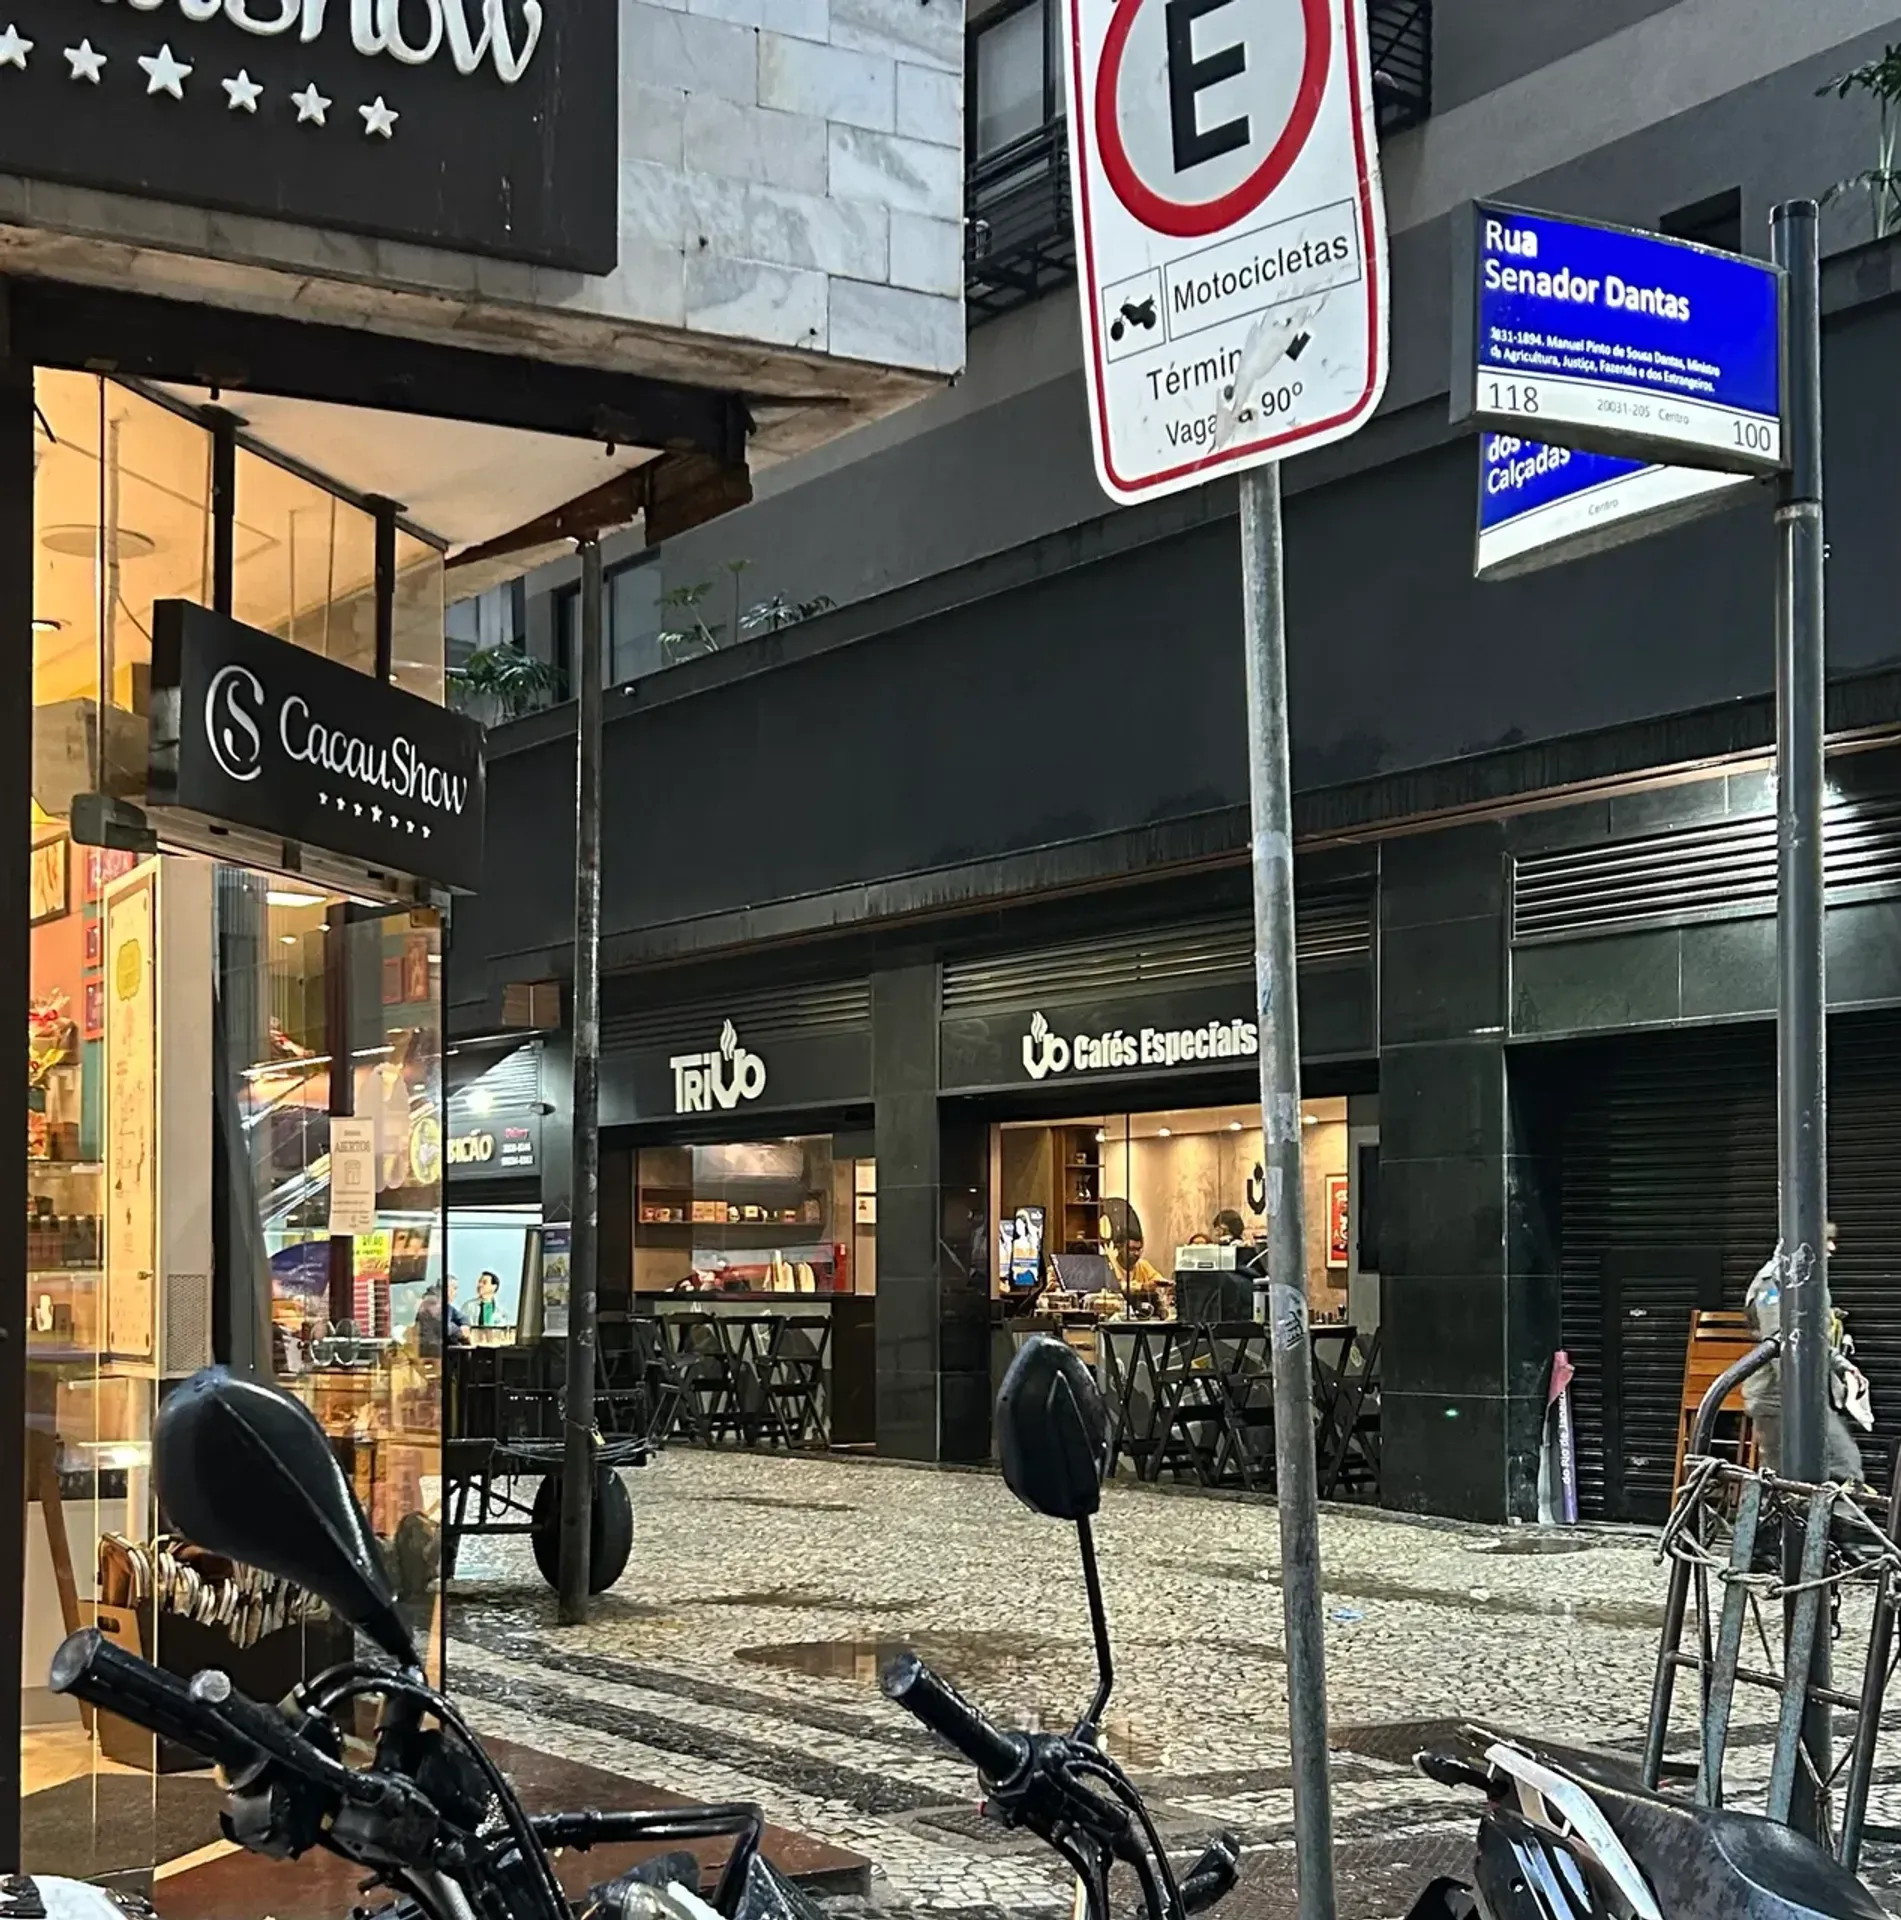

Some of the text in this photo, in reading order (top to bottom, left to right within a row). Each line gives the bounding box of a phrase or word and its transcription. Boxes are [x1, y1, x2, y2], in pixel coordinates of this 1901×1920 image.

[1165, 0, 1251, 174] E
[1486, 220, 1538, 257] Rua
[1173, 231, 1349, 313] Motocicletas
[1485, 260, 1691, 321] Senador Dantas
[1546, 335, 1585, 352] Manuel
[1586, 340, 1611, 356] Pinto
[1613, 344, 1626, 358] de
[1146, 346, 1243, 401] Términ
[1503, 348, 1561, 367] Agricultura,
[1563, 355, 1598, 373] Justiça,
[1599, 358, 1637, 378] Fazenda
[1646, 368, 1663, 381] dos
[1489, 382, 1540, 414] 118
[1597, 398, 1690, 426] 20031-205 Centro
[1166, 414, 1218, 447] Vaga
[1732, 419, 1772, 452] 100
[1488, 434, 1521, 463] dos
[1487, 444, 1572, 494] Calçadas
[1588, 499, 1619, 516] Centro
[1073, 1029, 1138, 1071] Cafés
[1140, 1019, 1258, 1066] Especiais
[1559, 1436, 1569, 1450] de
[1561, 1450, 1571, 1468] Rio
[1562, 1469, 1571, 1485] do
